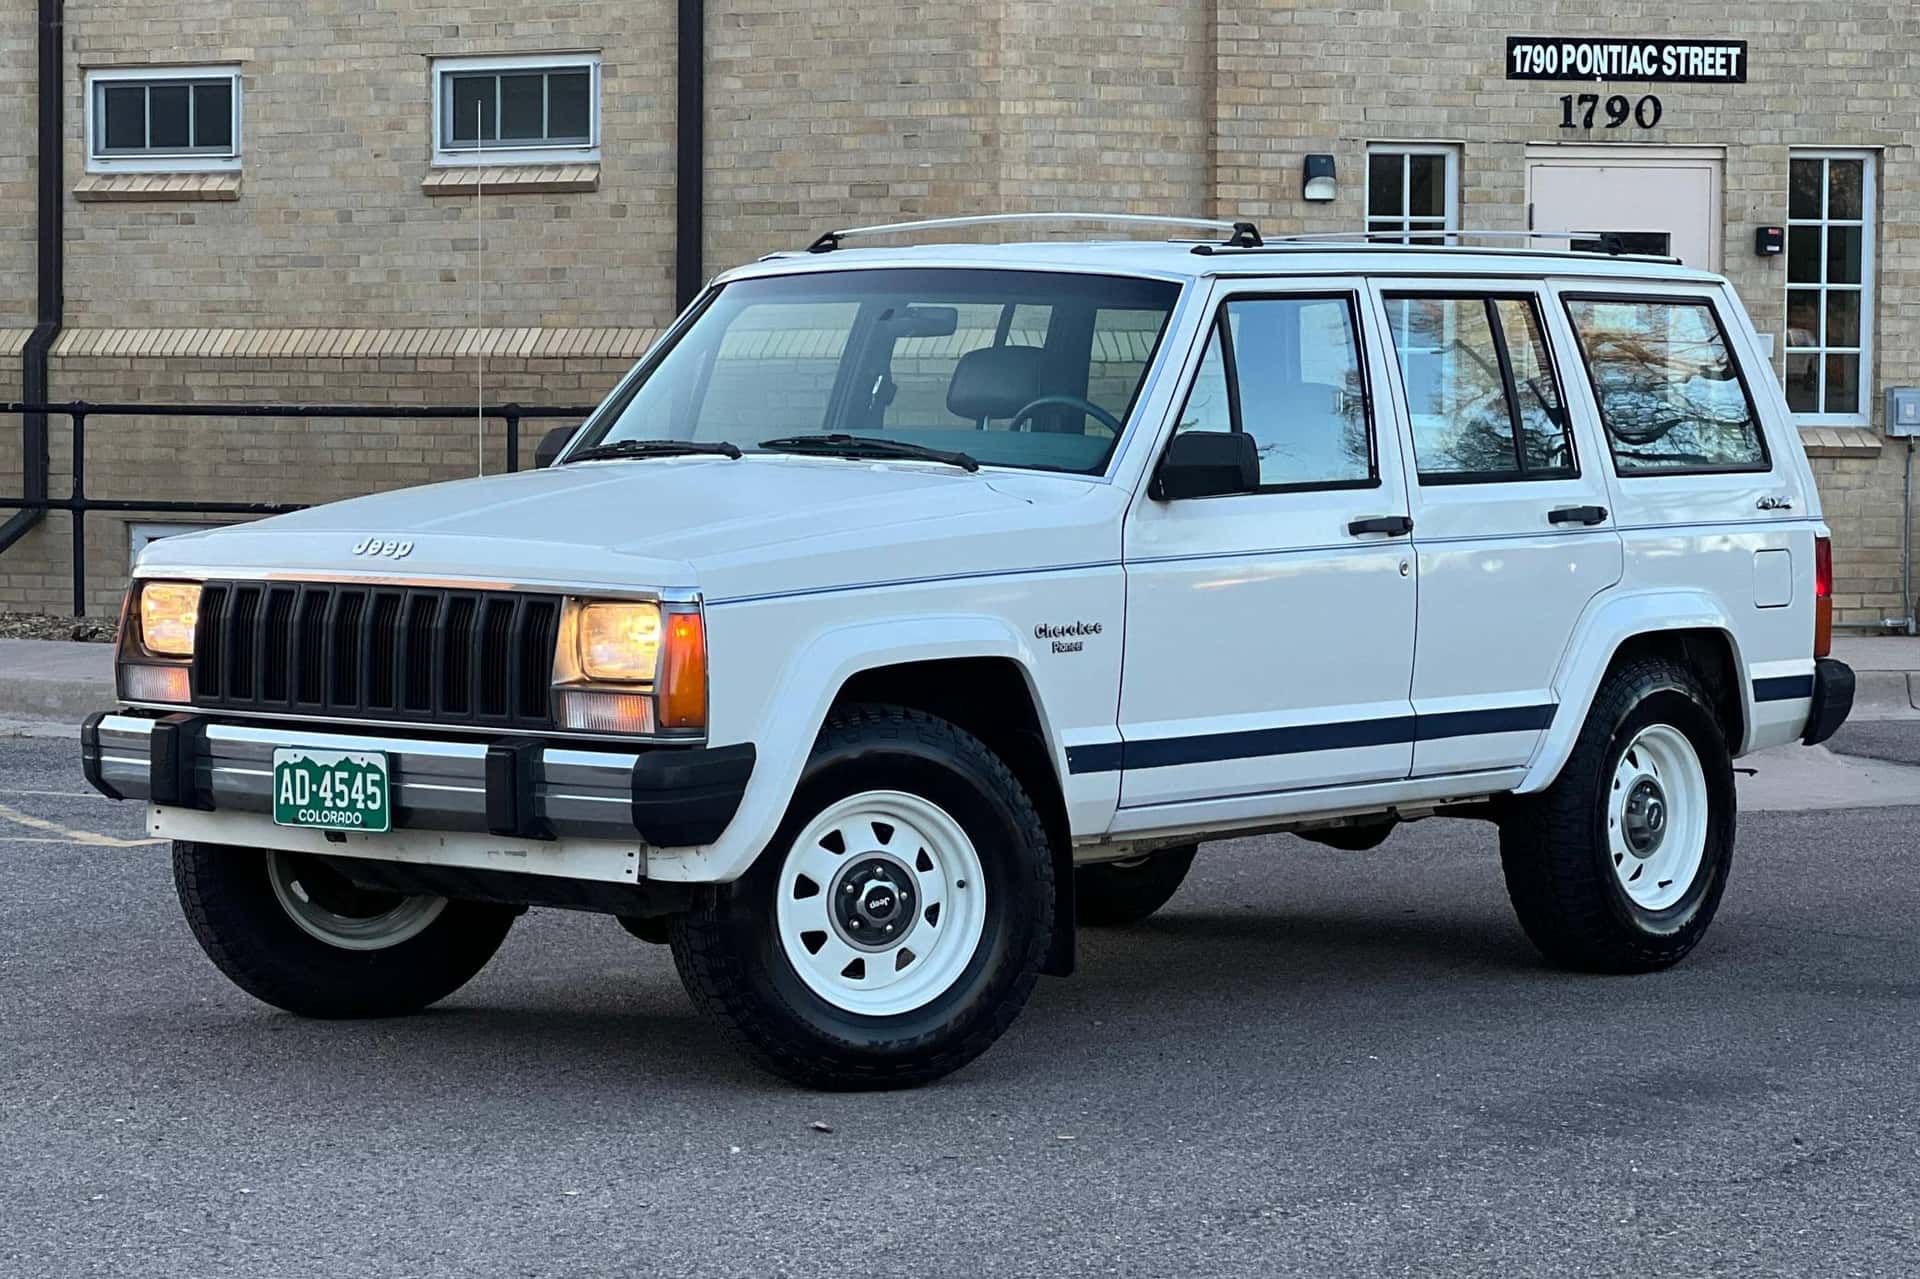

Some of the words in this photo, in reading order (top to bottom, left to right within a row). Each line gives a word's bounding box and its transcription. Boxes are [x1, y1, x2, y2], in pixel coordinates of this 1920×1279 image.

[1513, 44, 1558, 74] 1790
[1562, 43, 1658, 76] PONTIAC
[1662, 45, 1741, 76] STREET
[1559, 94, 1662, 129] 1790
[352, 535, 415, 561] Jeep
[1034, 620, 1103, 639] Cherokee
[298, 809, 362, 825] COLORADO
